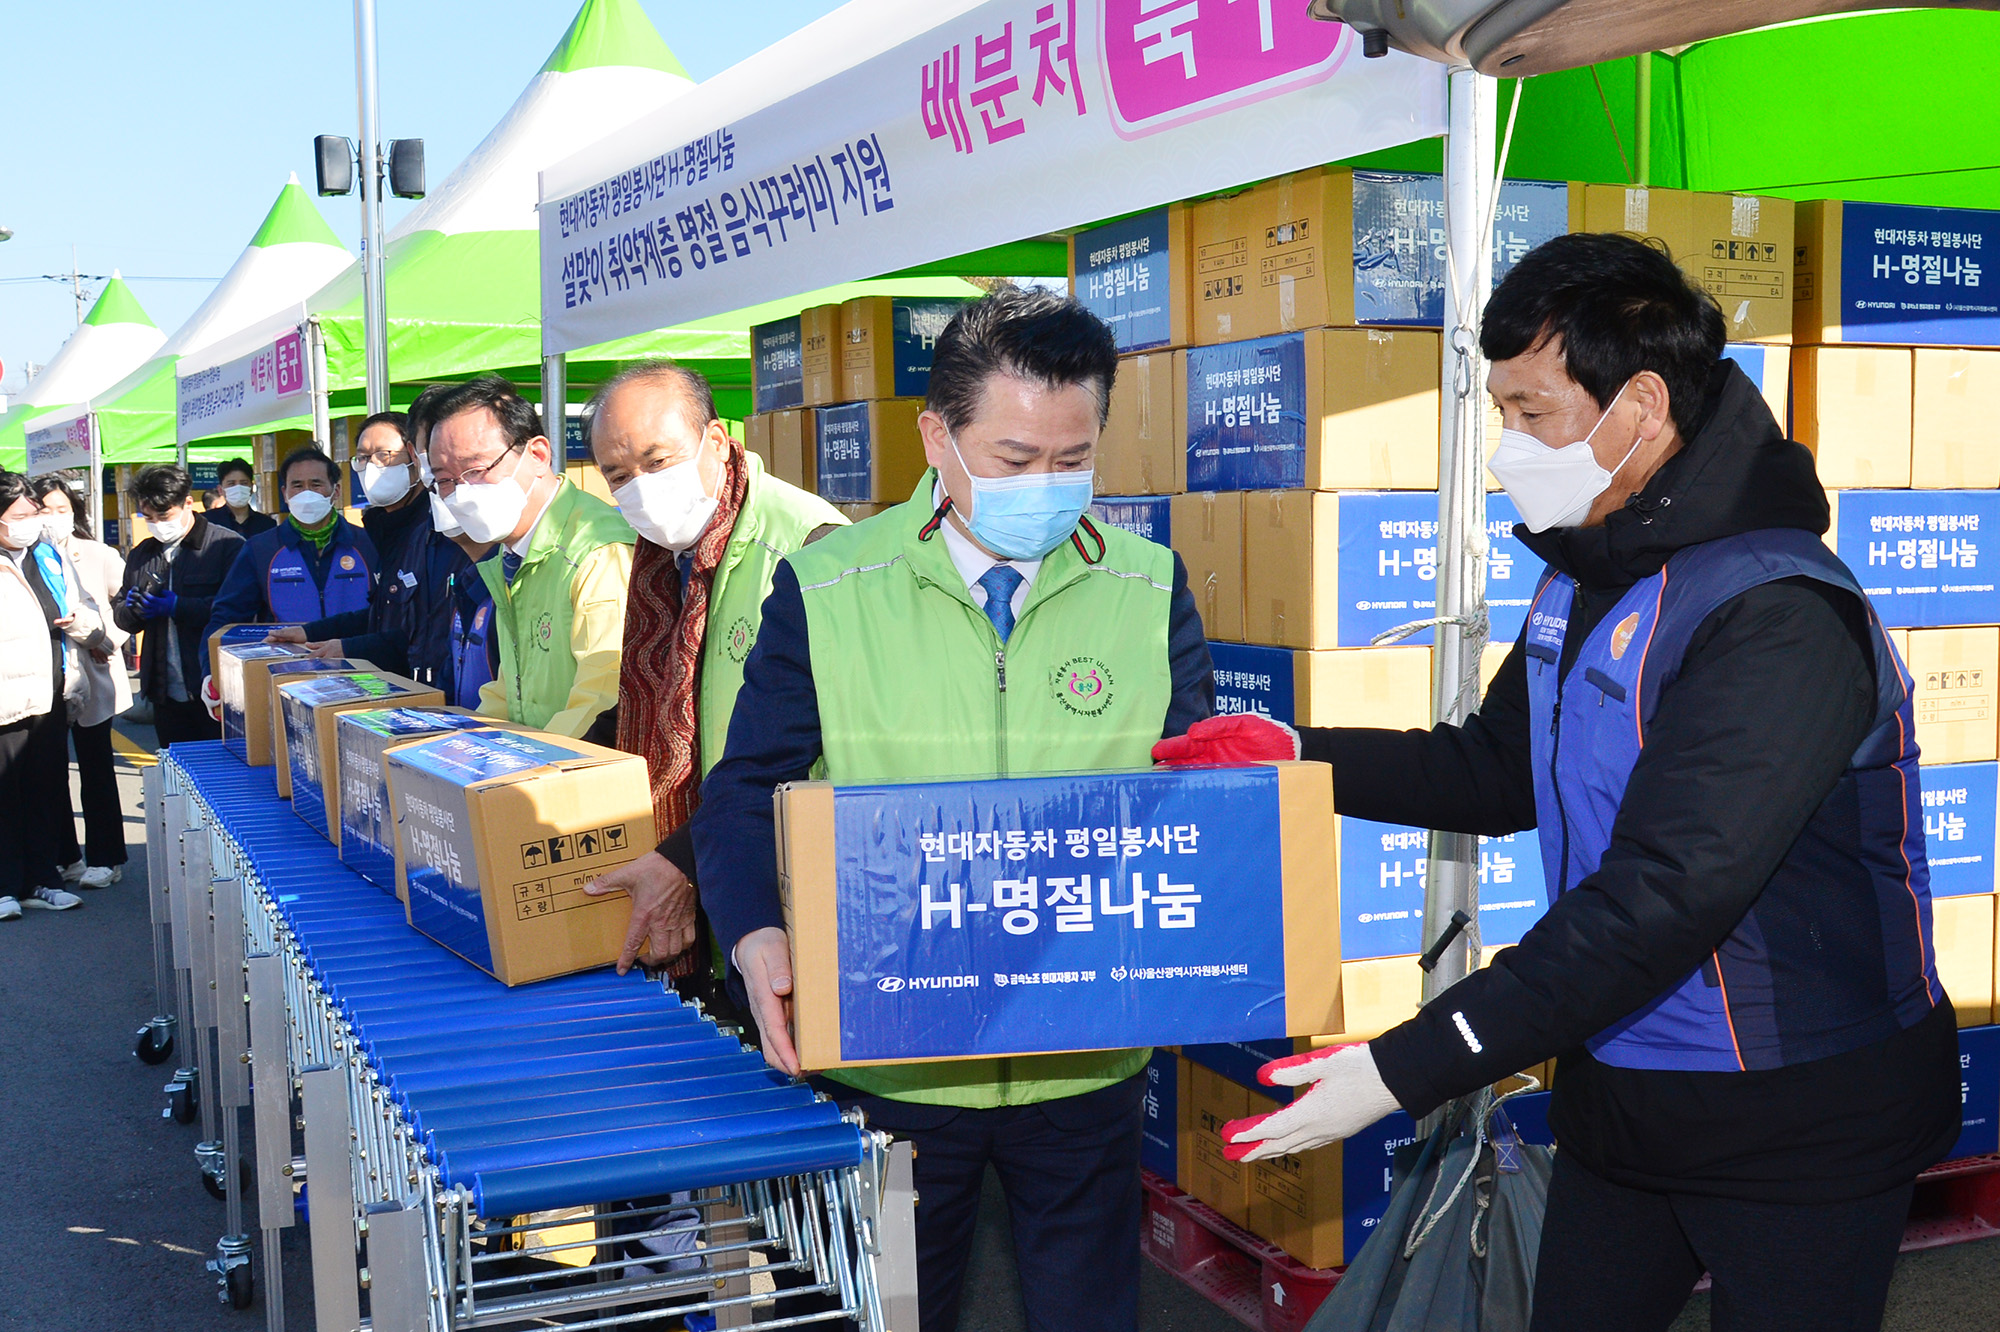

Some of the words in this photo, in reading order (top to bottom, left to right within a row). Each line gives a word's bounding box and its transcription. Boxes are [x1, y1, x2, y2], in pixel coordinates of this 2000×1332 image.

[921, 0, 1087, 154] 배분처
[559, 181, 610, 239] 현대자동차
[610, 154, 667, 218] 평일봉사단
[669, 127, 736, 188] H-명절나눔
[561, 241, 609, 309] 설맞이
[607, 215, 683, 291] 취약계층
[676, 198, 728, 271] 명절
[720, 154, 840, 258] 음식꾸러미
[831, 132, 894, 217] 지원
[1089, 244, 1118, 268] 현대자동차
[1119, 236, 1150, 260] 평일봉사단
[1874, 228, 1929, 247] 현대자동차
[1930, 231, 1983, 249] 평일봉사단
[1089, 263, 1150, 299] H-명절나눔
[1872, 254, 1983, 287] H-명절나눔
[279, 341, 299, 387] 동구
[1205, 369, 1242, 390] 현대자동차
[1242, 364, 1281, 386] 평일봉사단
[1205, 392, 1282, 428] H-명절나눔
[823, 438, 860, 460] H-명절나눔
[1870, 515, 1925, 532] 현대자동차
[1927, 514, 1980, 532] 평일봉사단
[1868, 538, 1979, 570] H-명절나눔
[1096, 660, 1114, 685] ULSAN
[1234, 671, 1271, 692] 평일봉사단
[410, 824, 462, 884] H-명절나눔
[919, 827, 1057, 862] 현대자동차
[1064, 824, 1200, 859] 평일봉사단
[919, 873, 1202, 936] H-명절나눔
[908, 975, 979, 990] HYUNDAI
[1010, 973, 1040, 985] 금속노조
[1080, 971, 1096, 982] 지부
[1129, 963, 1248, 980] (사)울산광역시자원봉사센터
